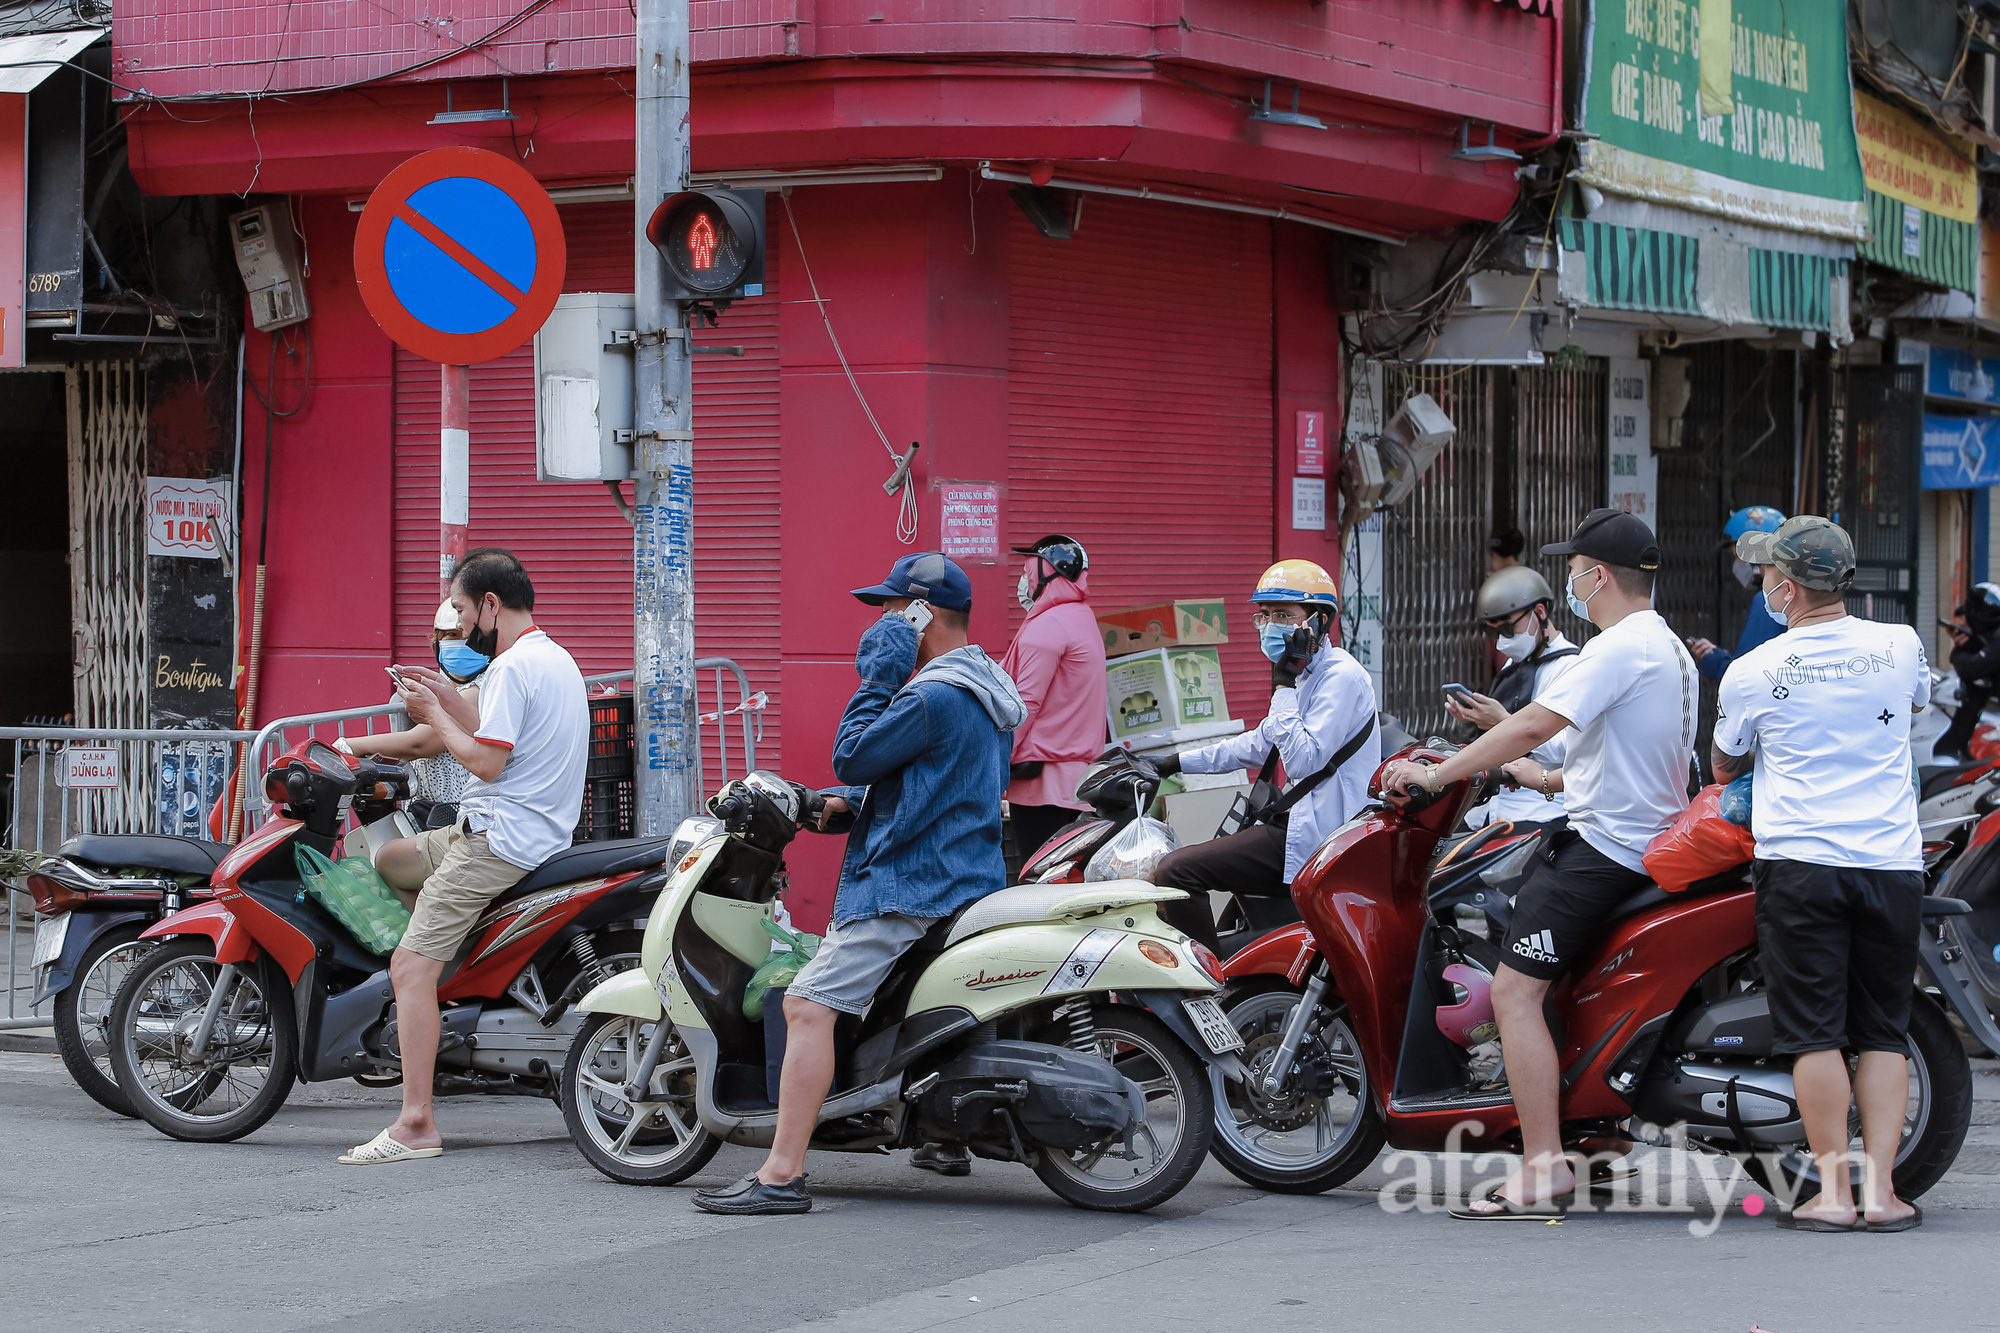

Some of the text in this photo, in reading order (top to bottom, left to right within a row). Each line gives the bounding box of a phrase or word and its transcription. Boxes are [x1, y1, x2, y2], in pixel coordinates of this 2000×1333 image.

[1611, 54, 1640, 121] CHÈ
[1756, 108, 1786, 163] CAO
[29, 273, 61, 293] 6789
[173, 498, 185, 516] MÍA
[188, 499, 204, 518] TRÂN
[163, 520, 213, 543] 10K
[1763, 650, 1895, 689] VUITTON
[1735, 738, 1745, 746] L
[71, 761, 116, 780] DỪNG LẠI
[221, 892, 244, 901] HONDA
[1512, 942, 1560, 963] adidas
[953, 973, 972, 983] mio
